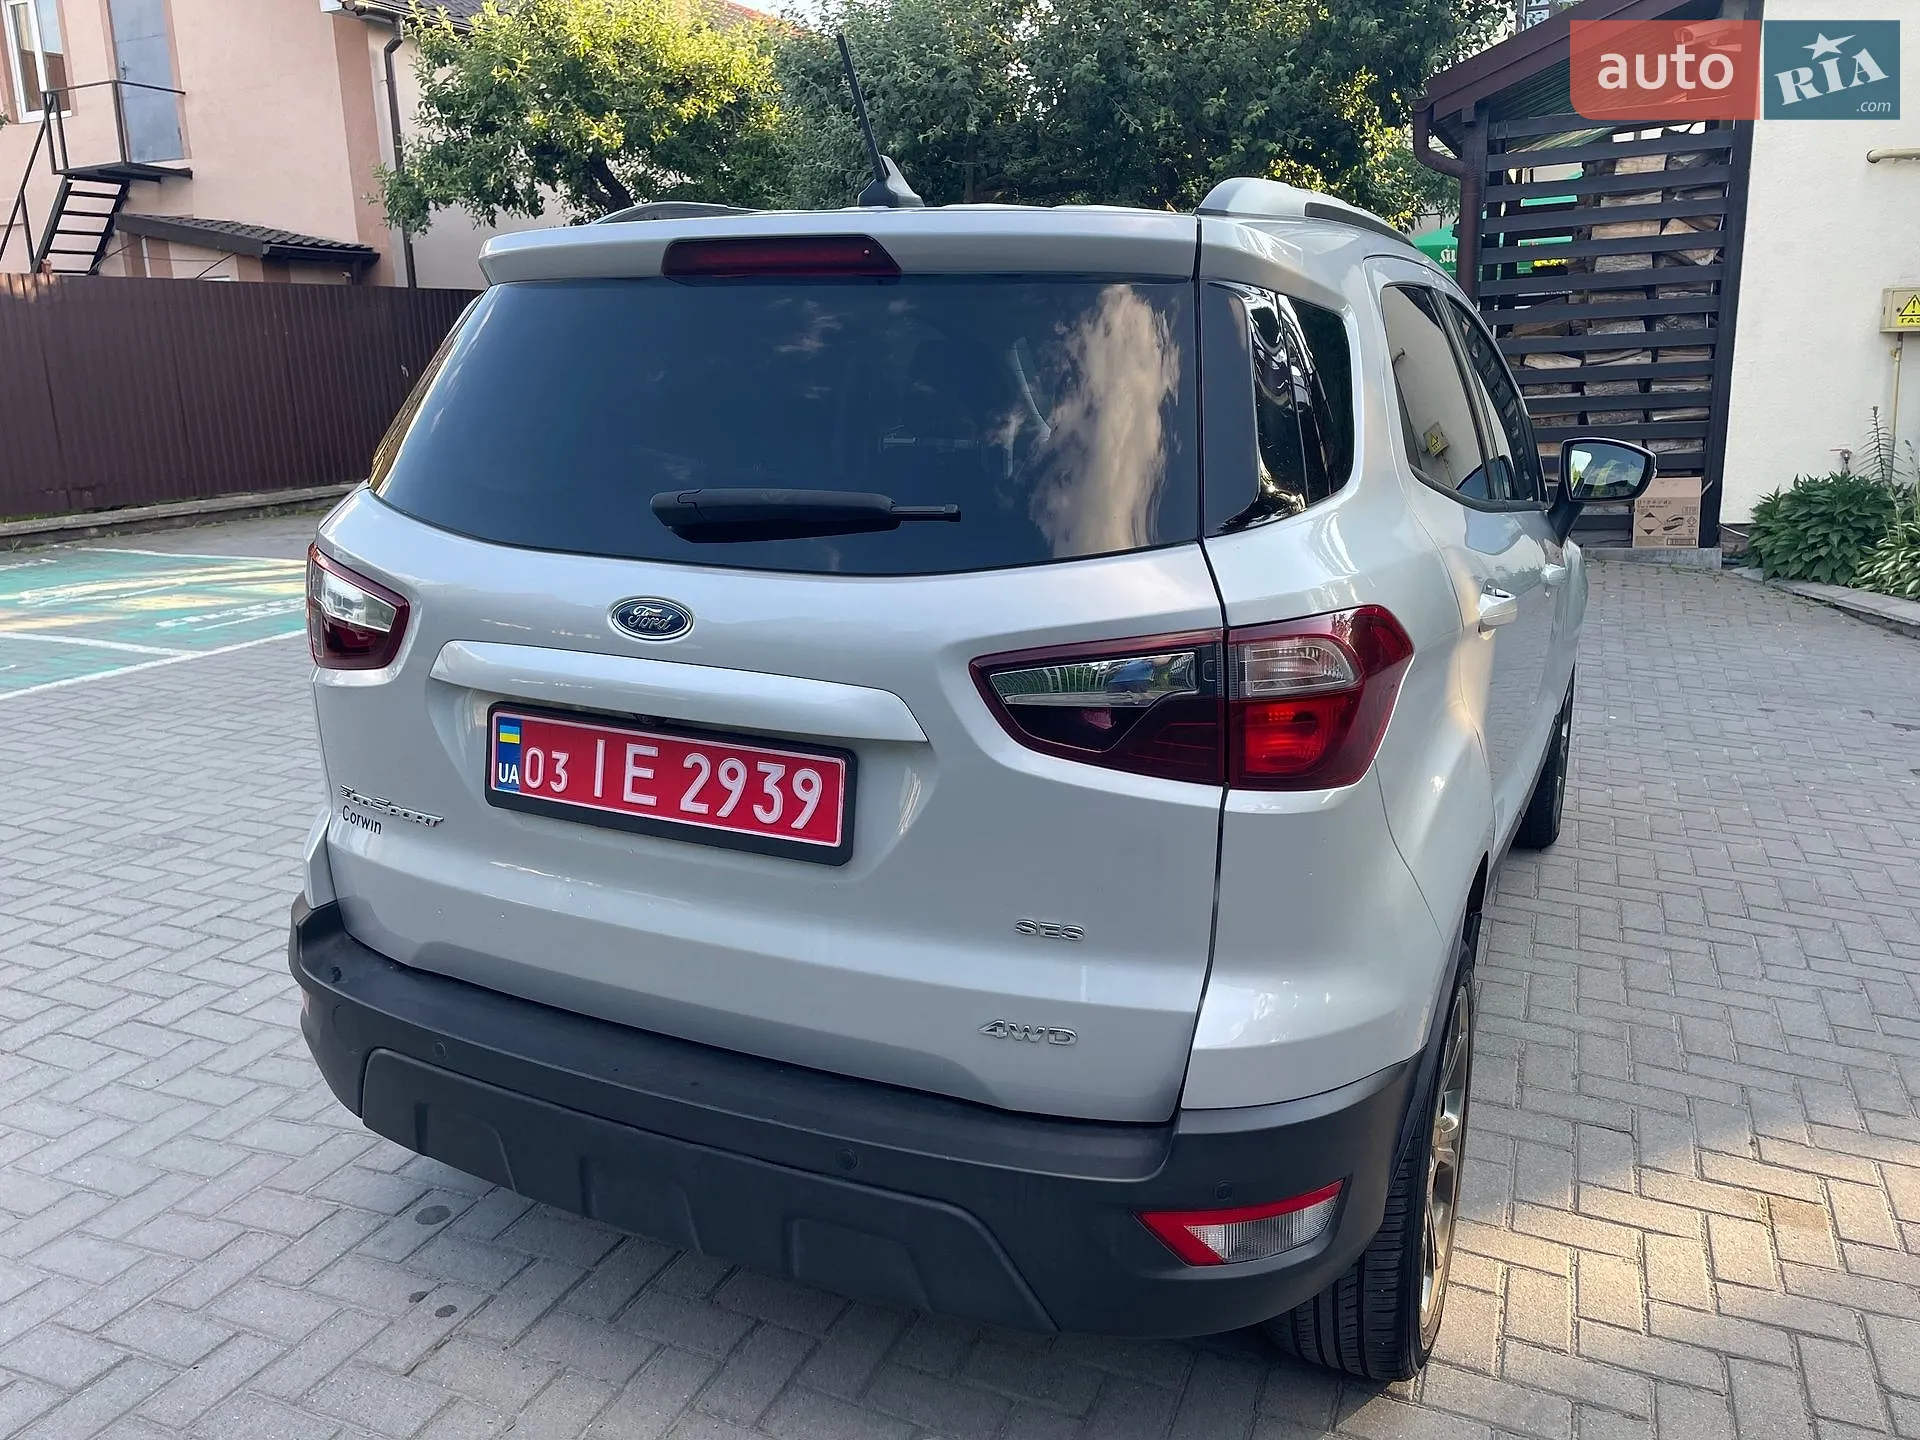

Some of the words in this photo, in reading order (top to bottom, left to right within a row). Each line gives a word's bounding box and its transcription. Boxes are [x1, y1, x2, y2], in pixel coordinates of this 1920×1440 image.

[627, 605, 672, 631] Ford
[498, 762, 520, 785] UA
[524, 747, 570, 793] 03
[679, 752, 823, 829] 2939
[342, 805, 382, 835] Corwin
[1015, 919, 1086, 941] SES
[978, 1019, 1079, 1046] 4WD
